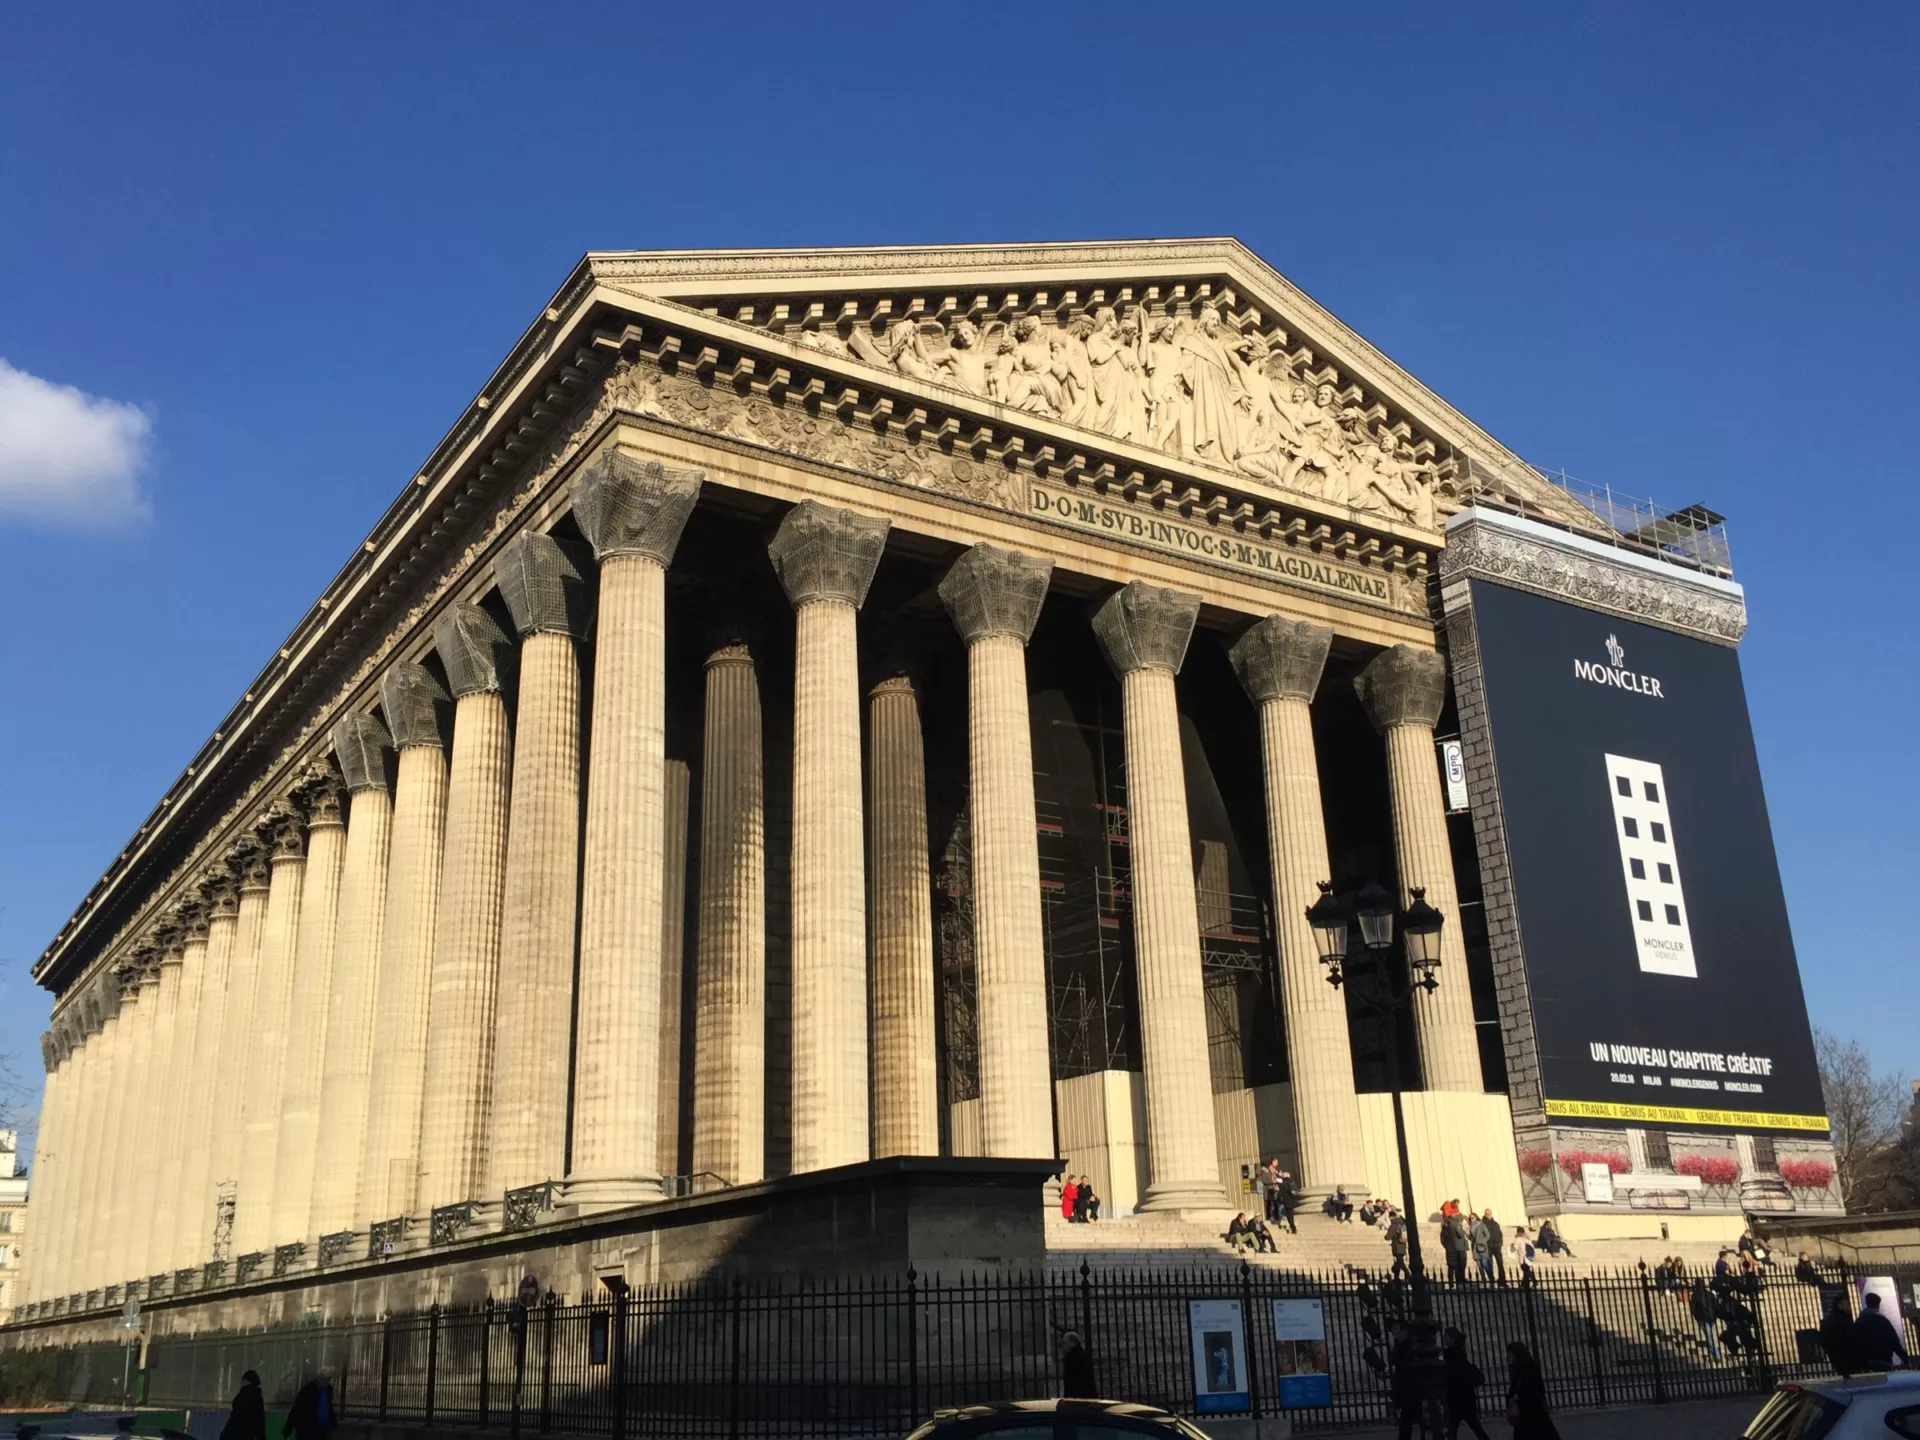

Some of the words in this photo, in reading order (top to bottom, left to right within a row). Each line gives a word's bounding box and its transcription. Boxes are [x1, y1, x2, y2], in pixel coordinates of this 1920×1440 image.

[1574, 658, 1664, 698] MONCLER
[1644, 937, 1685, 953] MONCLER
[1590, 1042, 1608, 1062] UN
[1610, 1044, 1668, 1068] NOUVEAU
[1669, 1050, 1727, 1072] CHAPITRE
[1727, 1052, 1773, 1076] CRÉATIF
[1568, 1103, 1579, 1115] AU
[1580, 1103, 1612, 1117] TRAVAIL
[1620, 1105, 1646, 1119] GENIUS
[1647, 1107, 1658, 1119] AU
[1658, 1108, 1688, 1121] TRAVAIL
[1697, 1111, 1721, 1124] GENIUS
[1722, 1112, 1732, 1123] AU
[1732, 1113, 1760, 1126] TRAVAIL
[1767, 1115, 1791, 1127] GENIUS
[1792, 1116, 1801, 1127] AU
[1801, 1117, 1828, 1129] TRAVAIL
